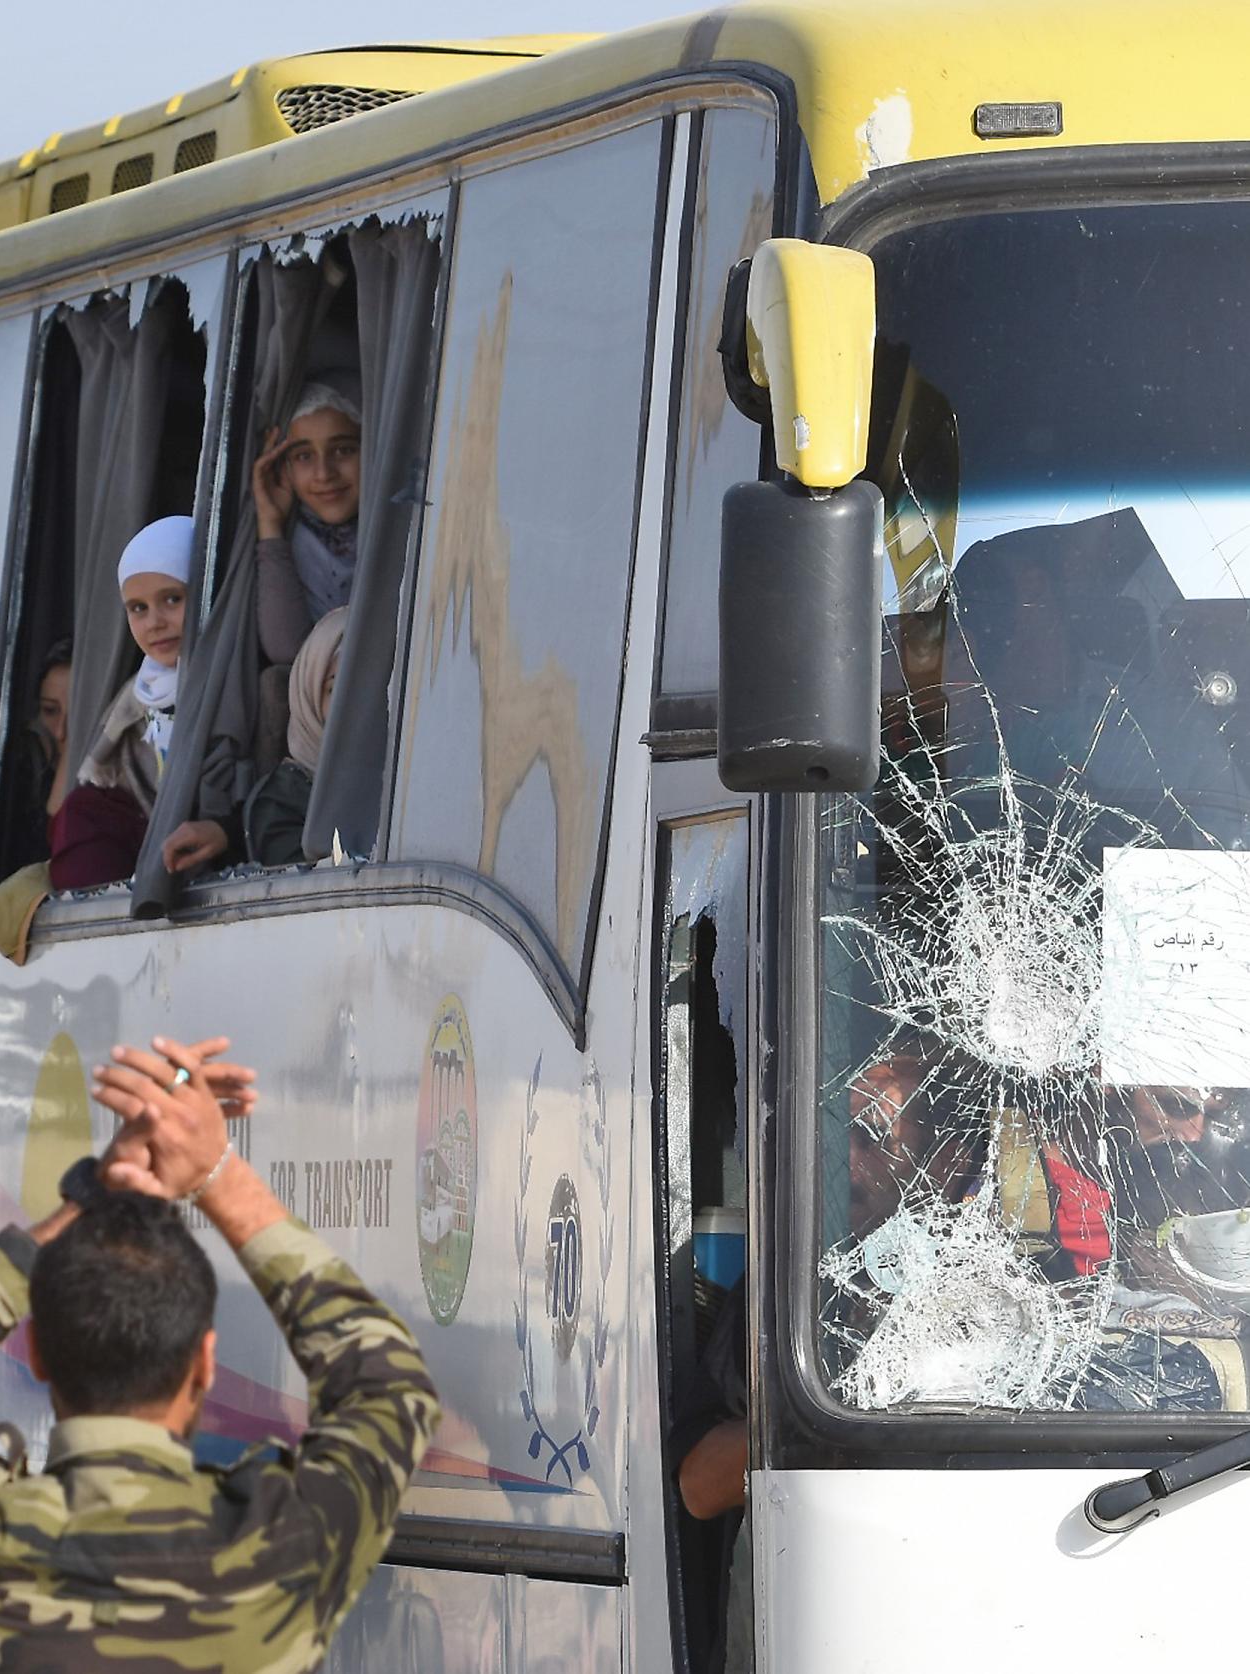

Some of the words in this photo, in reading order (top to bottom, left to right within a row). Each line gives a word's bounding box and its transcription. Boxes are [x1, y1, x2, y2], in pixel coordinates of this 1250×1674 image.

[1153, 931, 1196, 949] الباص
[1200, 931, 1224, 951] رقم
[305, 1159, 392, 1228] TRANSPORT
[550, 1217, 578, 1323] 70
